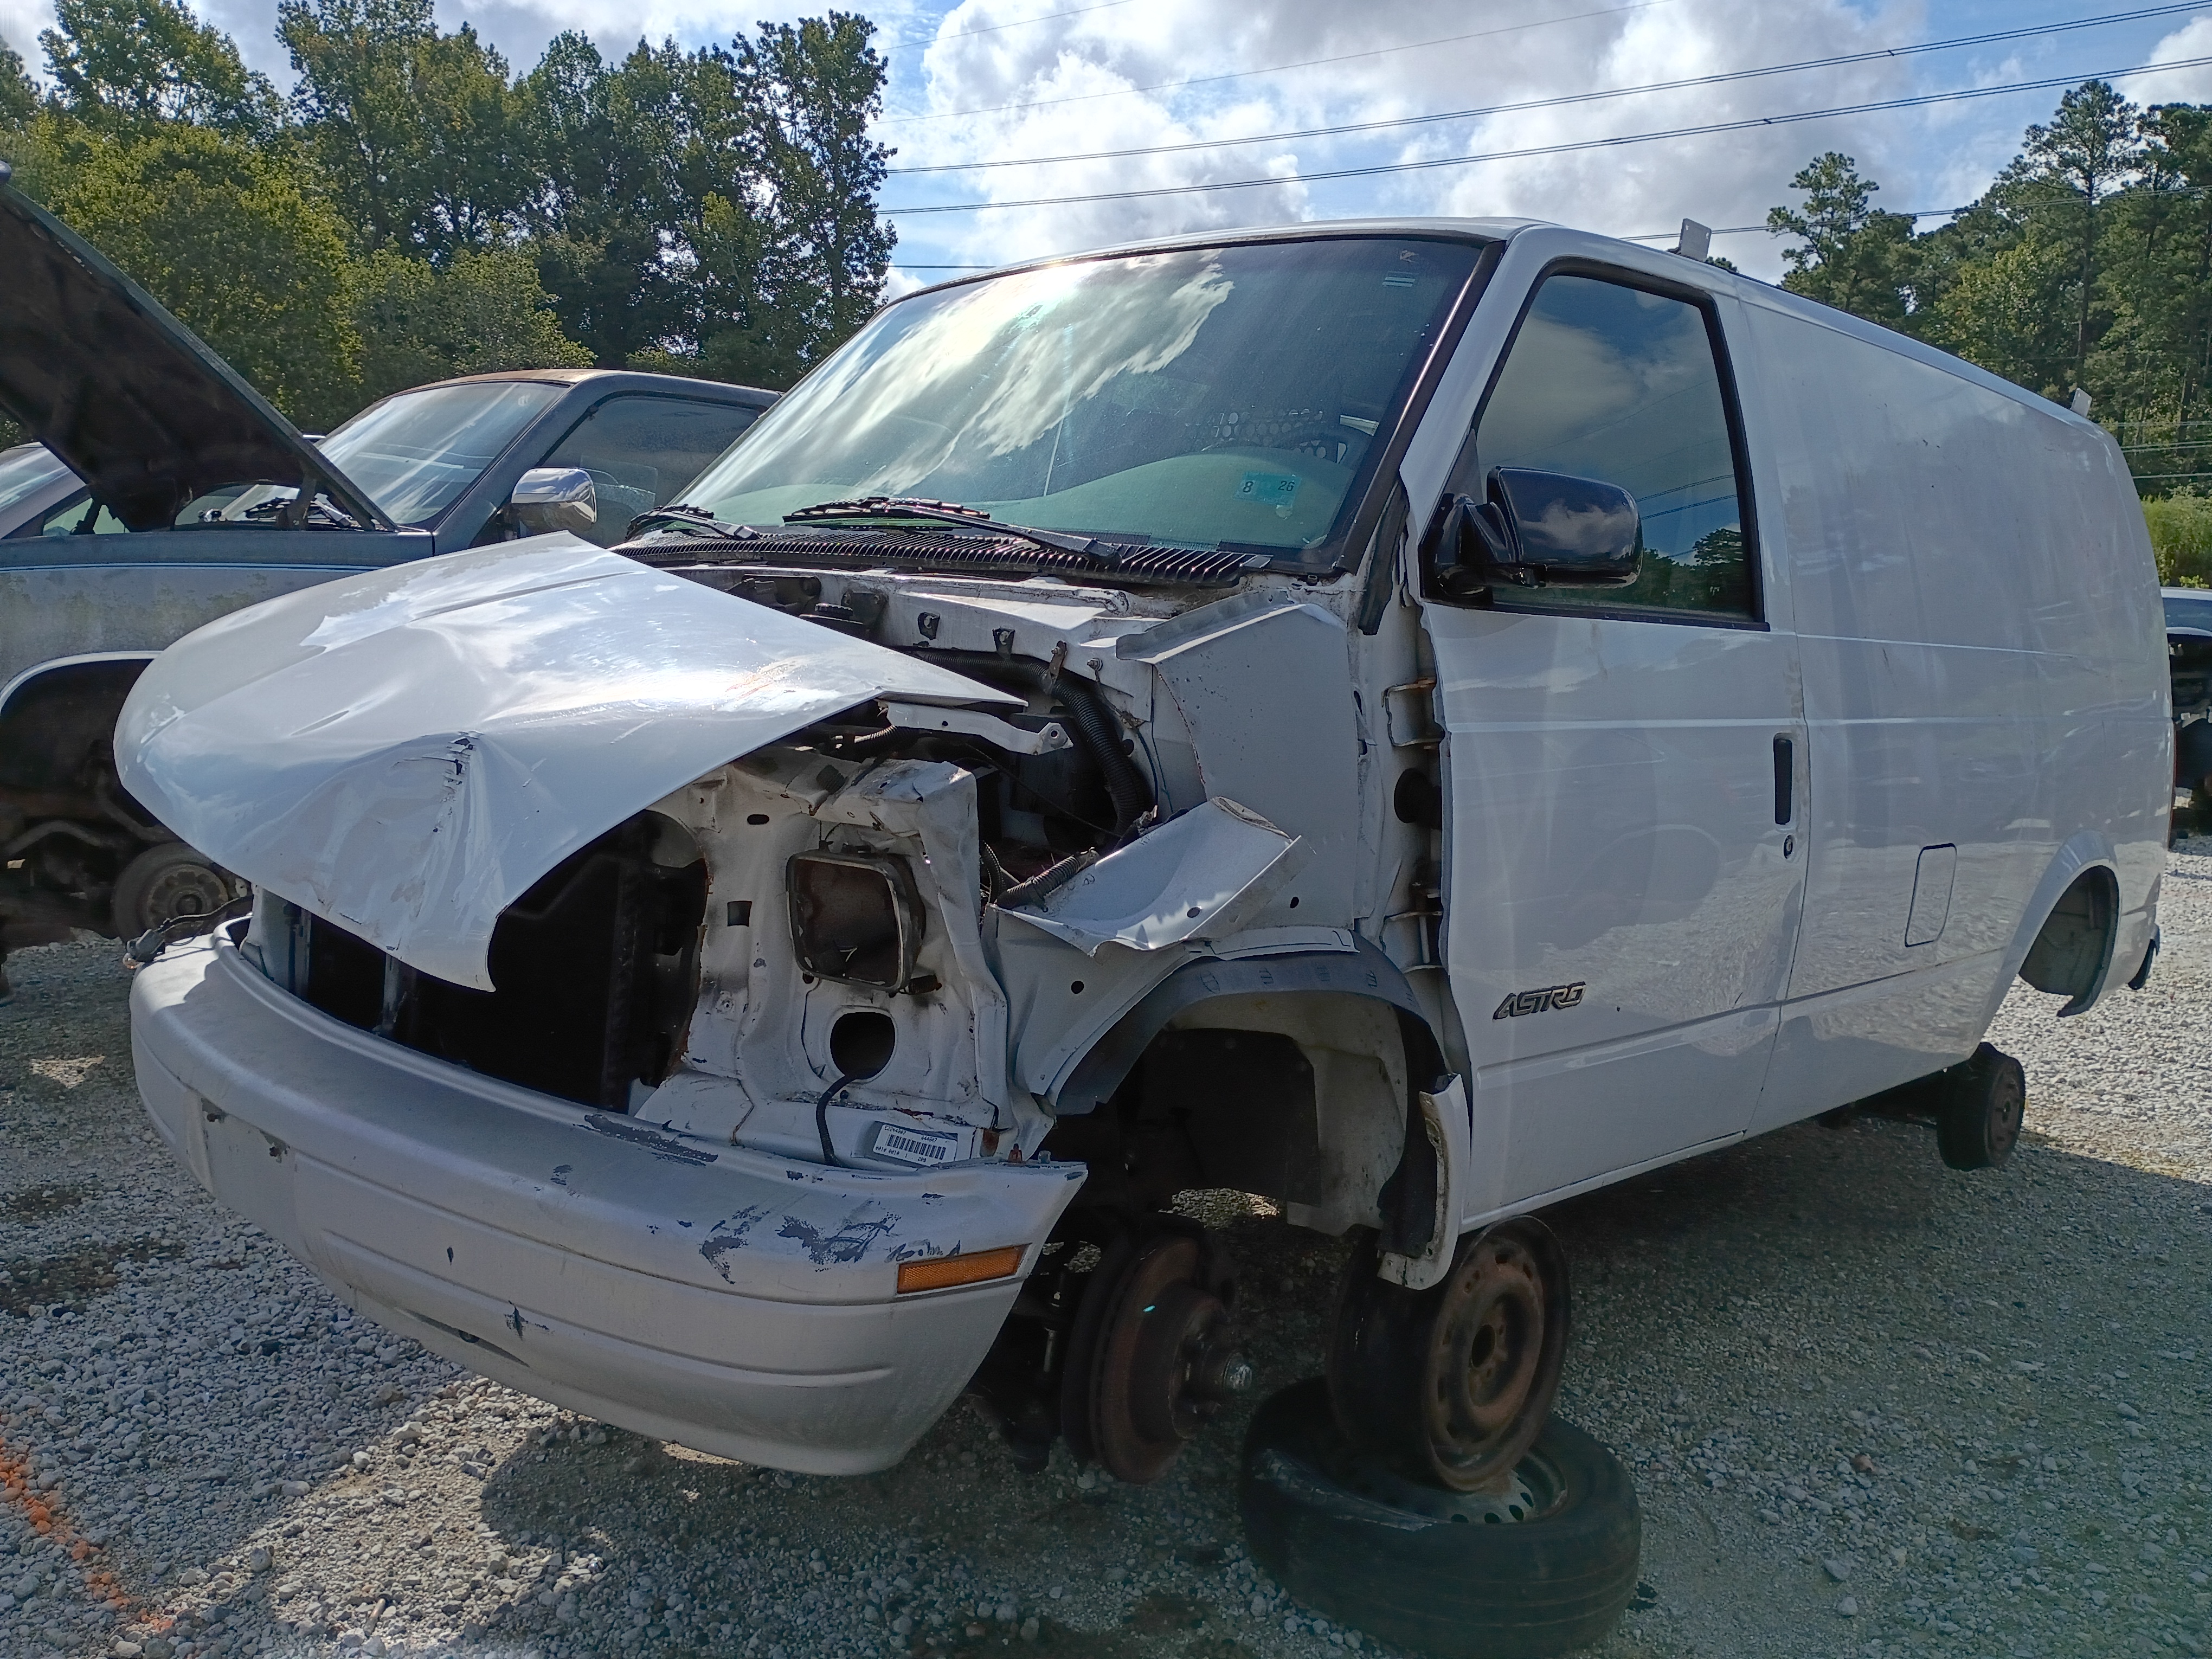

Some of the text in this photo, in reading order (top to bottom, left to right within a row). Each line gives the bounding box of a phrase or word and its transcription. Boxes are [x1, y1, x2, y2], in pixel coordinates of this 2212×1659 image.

[1243, 480, 1295, 493] 8 26
[1493, 981, 1586, 1020] ASTRO
